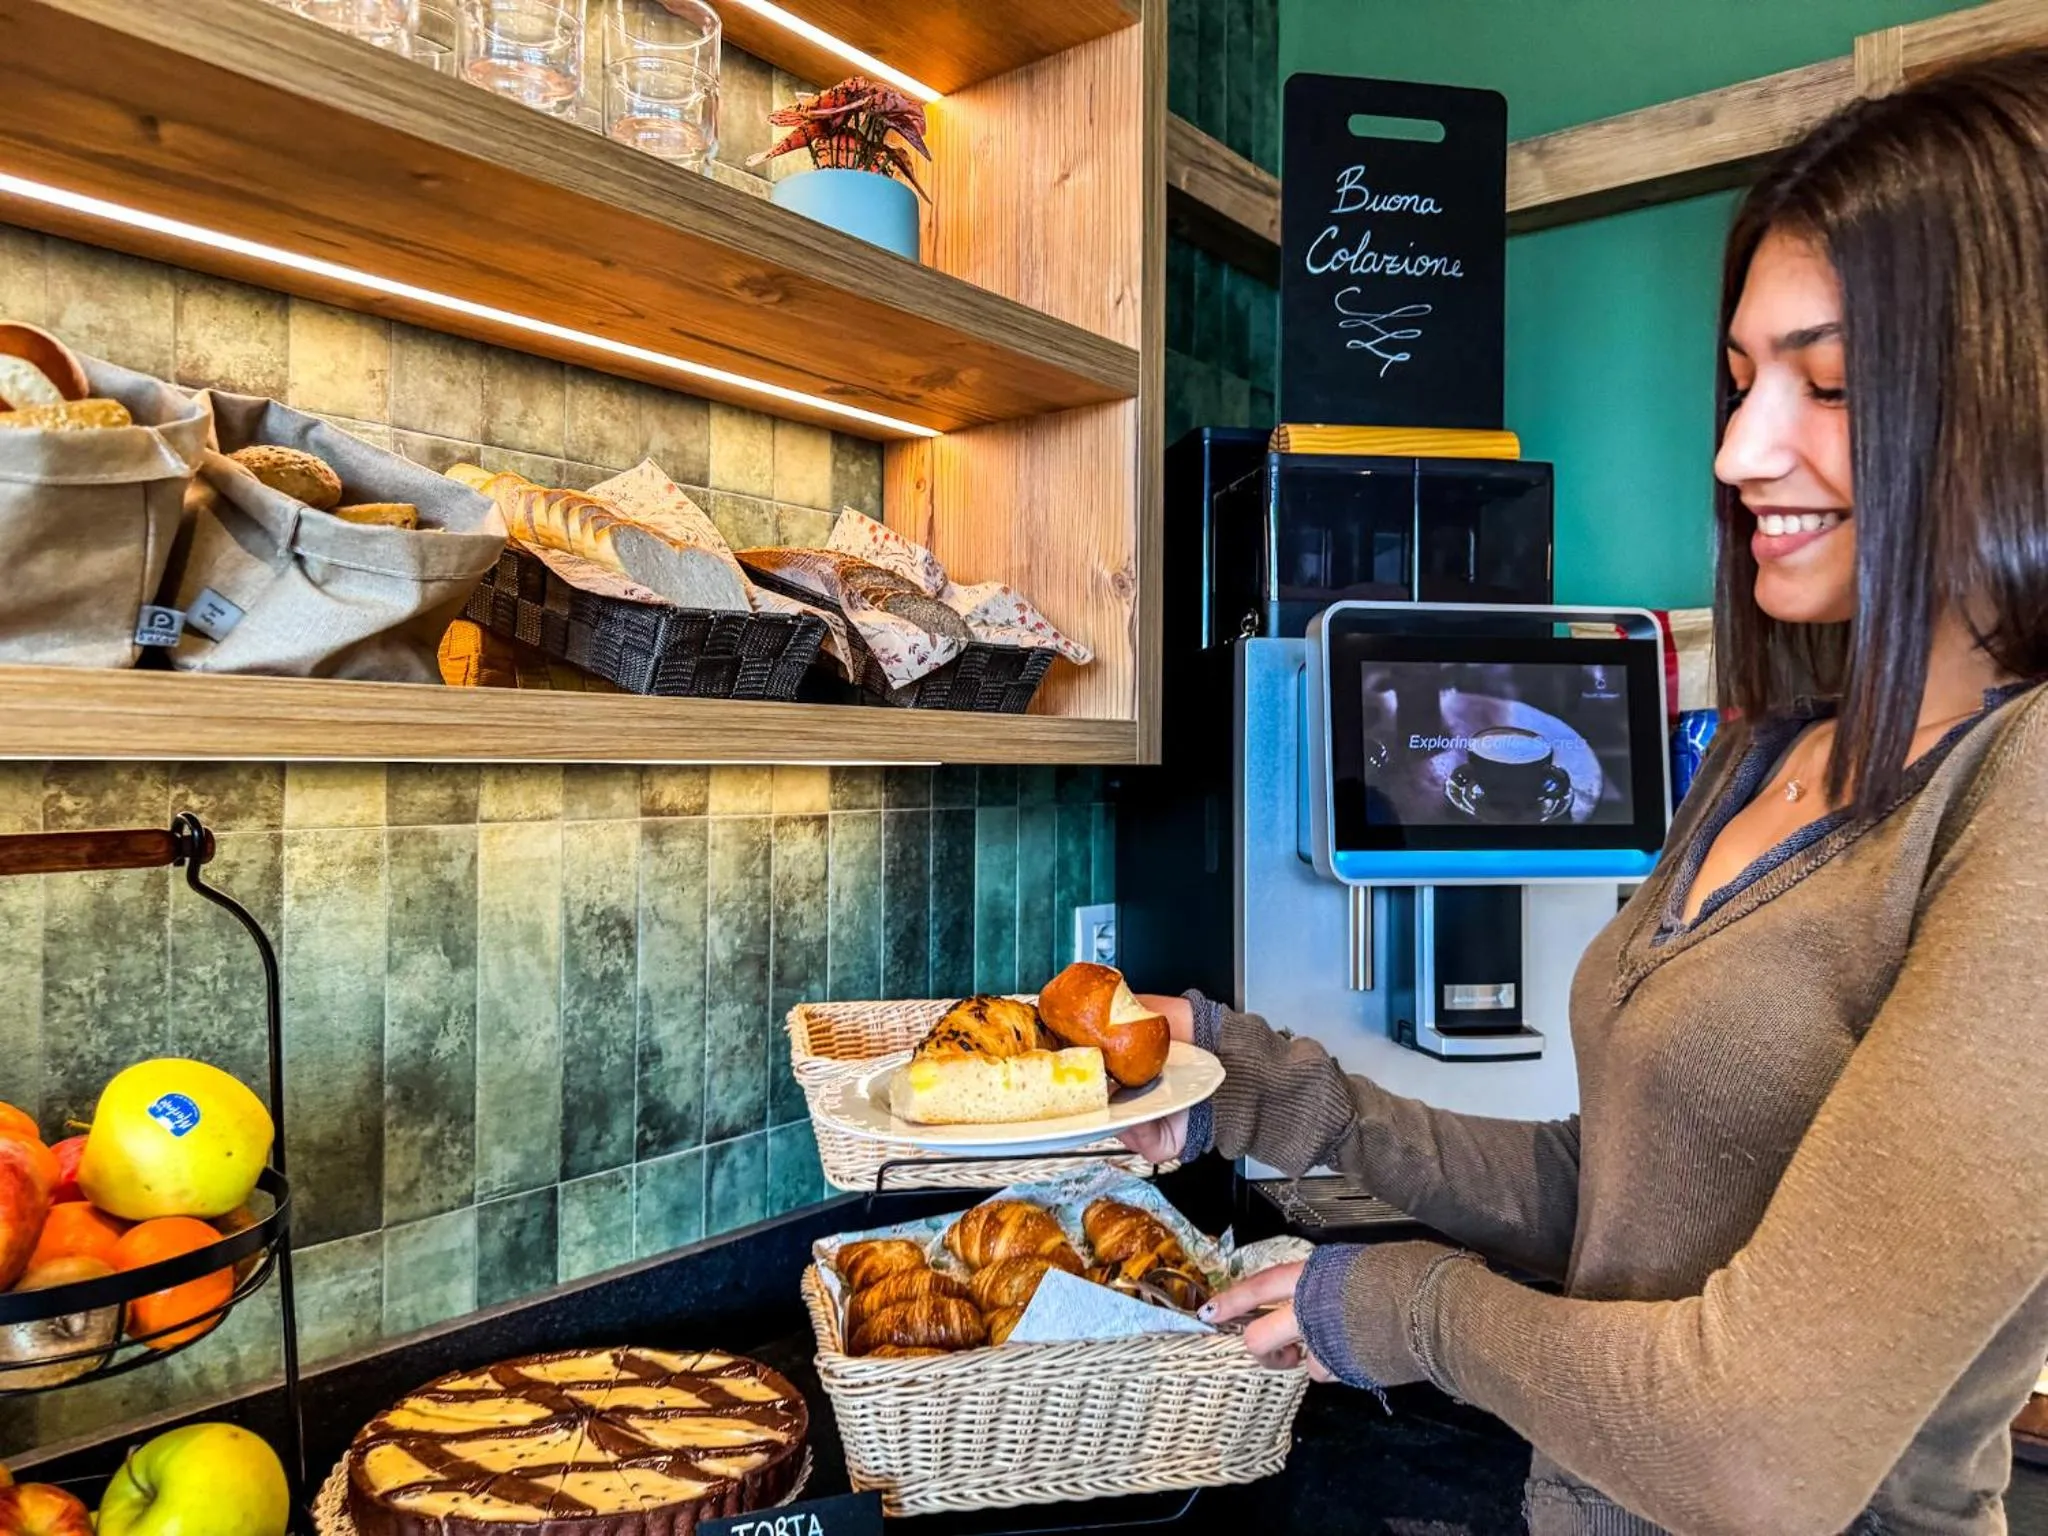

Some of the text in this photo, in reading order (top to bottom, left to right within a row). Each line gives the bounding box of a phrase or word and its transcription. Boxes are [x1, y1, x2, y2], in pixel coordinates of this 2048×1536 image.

[1330, 165, 1443, 215] Buona
[1305, 224, 1465, 278] Colazione
[1408, 734, 1477, 751] Exploring
[731, 1513, 824, 1536] TORTA
